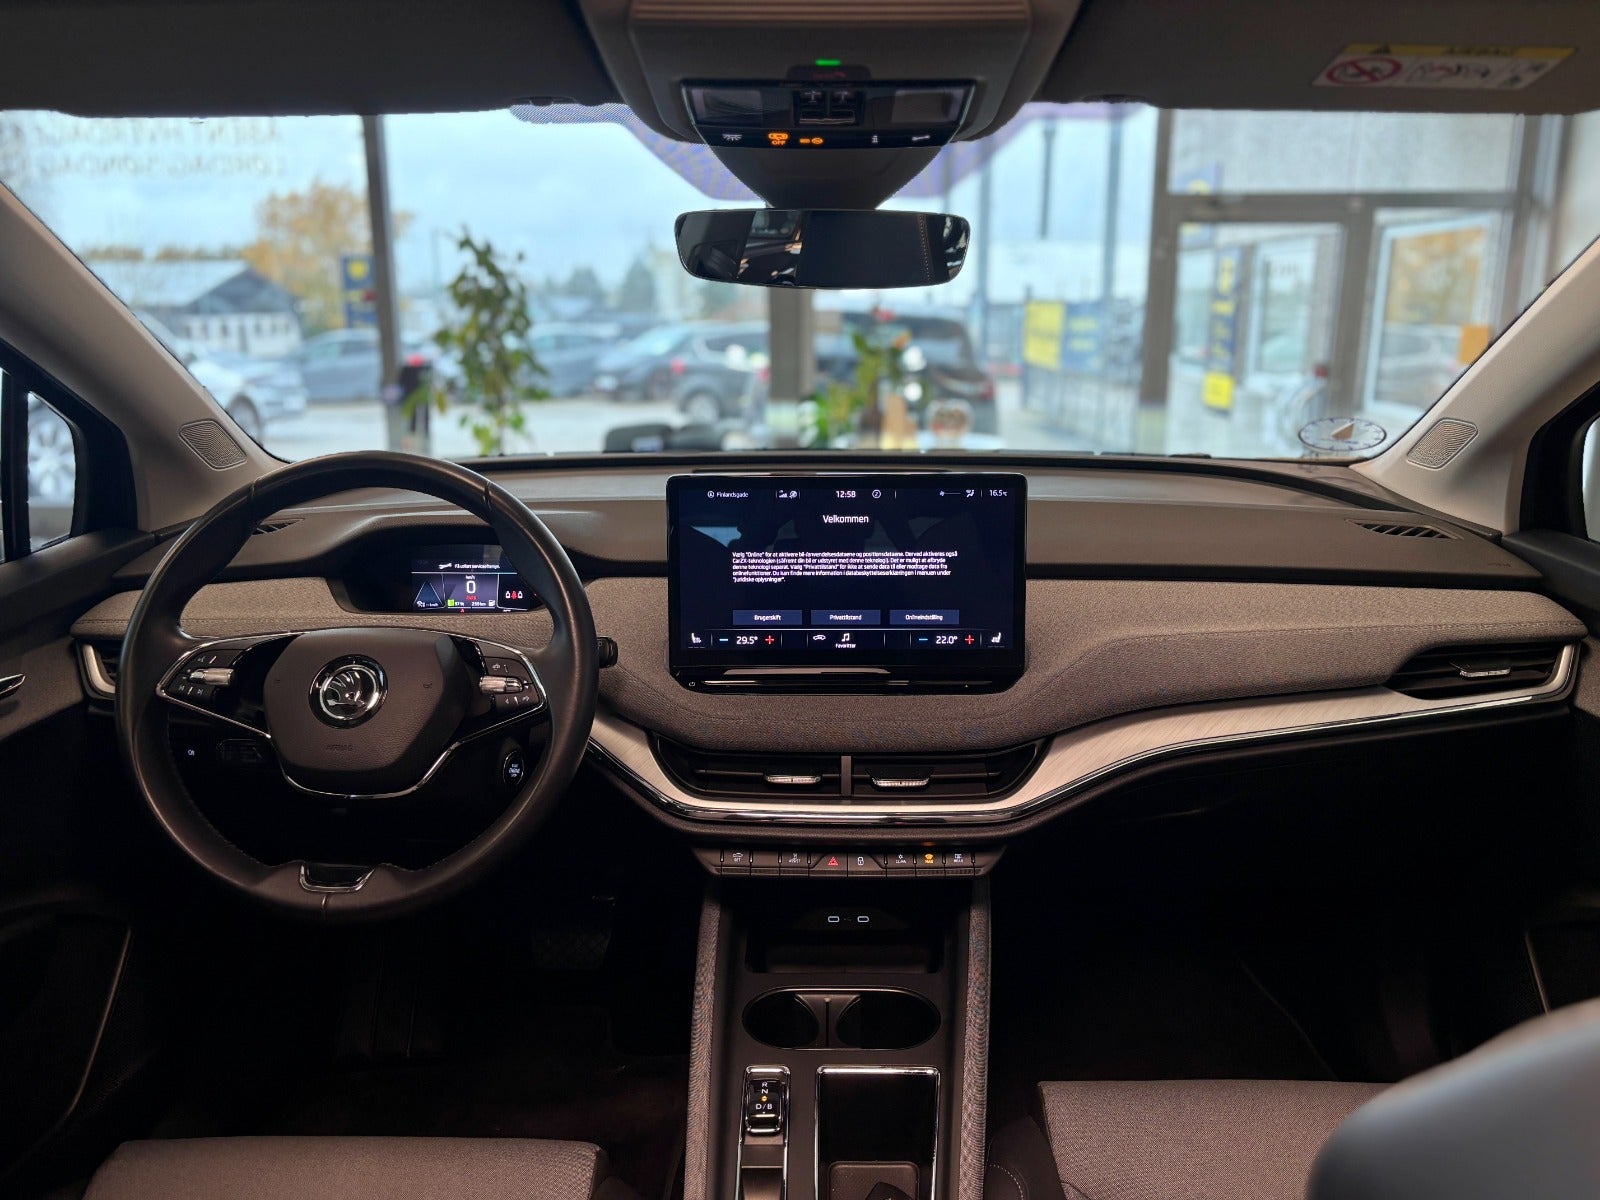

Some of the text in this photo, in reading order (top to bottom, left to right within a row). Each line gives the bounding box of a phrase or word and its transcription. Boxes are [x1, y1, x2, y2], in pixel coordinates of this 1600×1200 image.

[836, 490, 856, 498] 12:58
[822, 514, 869, 524] Velkommen
[466, 580, 476, 594] 0
[736, 636, 758, 644] 29.5°
[936, 636, 958, 644] 22.0°
